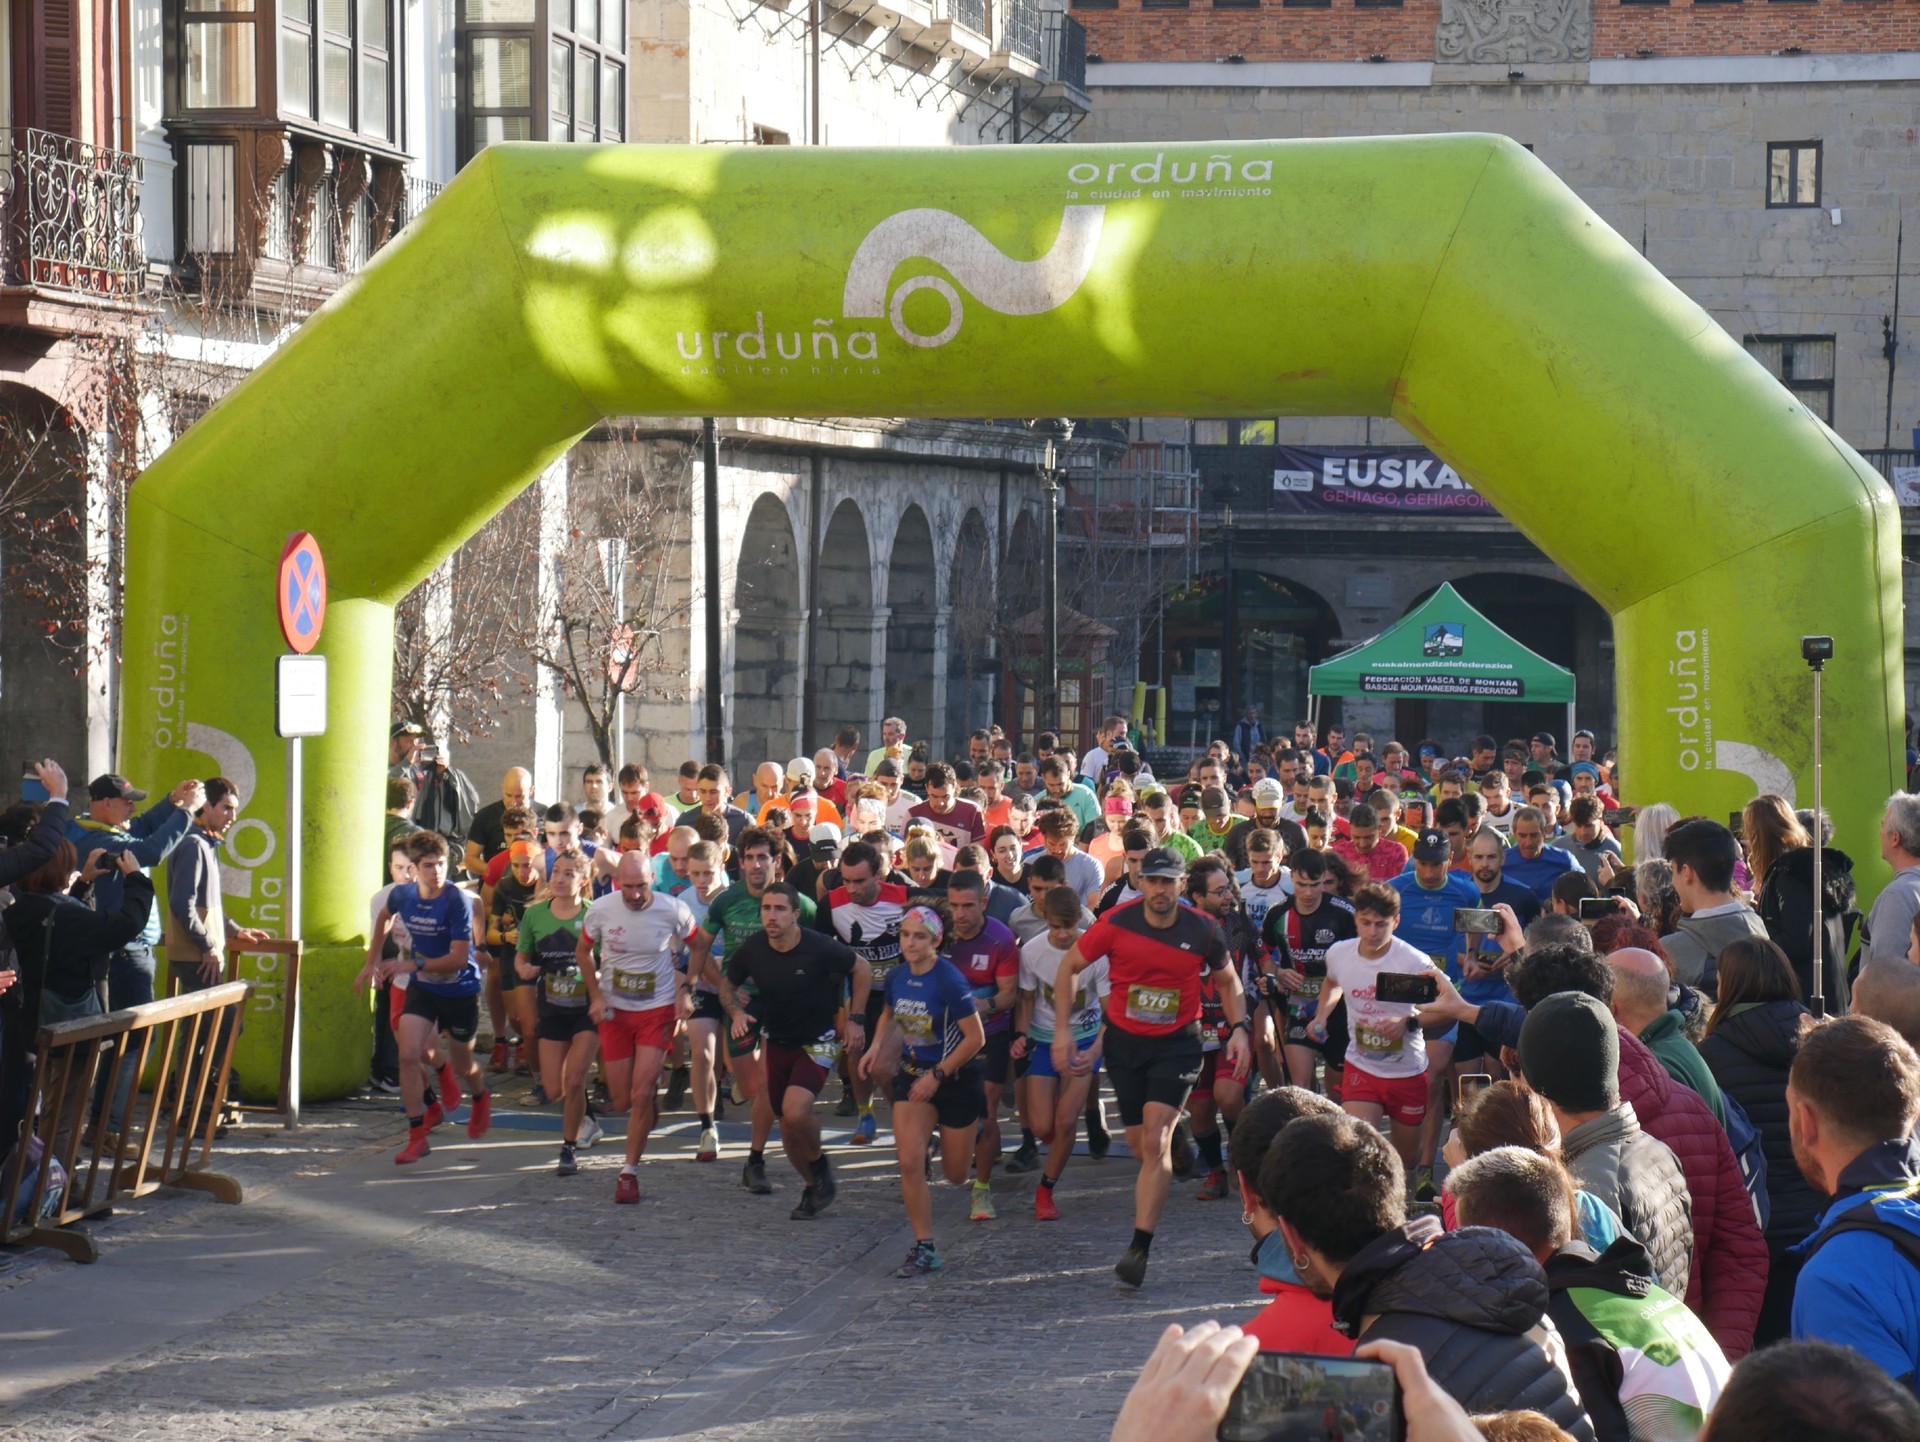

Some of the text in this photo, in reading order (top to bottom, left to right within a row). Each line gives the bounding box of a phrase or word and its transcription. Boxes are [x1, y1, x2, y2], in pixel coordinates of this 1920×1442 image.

[1067, 152, 1273, 184] orduña
[1066, 187, 1272, 199] la ciudad en movimiento
[676, 311, 879, 360] urduña
[811, 364, 881, 375] hiria
[1323, 457, 1474, 489] EUSKA
[1323, 489, 1400, 506] GEHIAGO,
[1701, 627, 1710, 691] movimiento
[150, 614, 179, 749] orduña
[1365, 683, 1518, 695] BASQUE MOUNTAINEERING FEDERATION
[1425, 676, 1455, 684] VASCA
[1459, 677, 1471, 685] DE
[1474, 679, 1518, 687] MONTAÑA
[1667, 630, 1700, 771] orduña
[1702, 698, 1711, 711] en
[1703, 717, 1712, 753] ciudad
